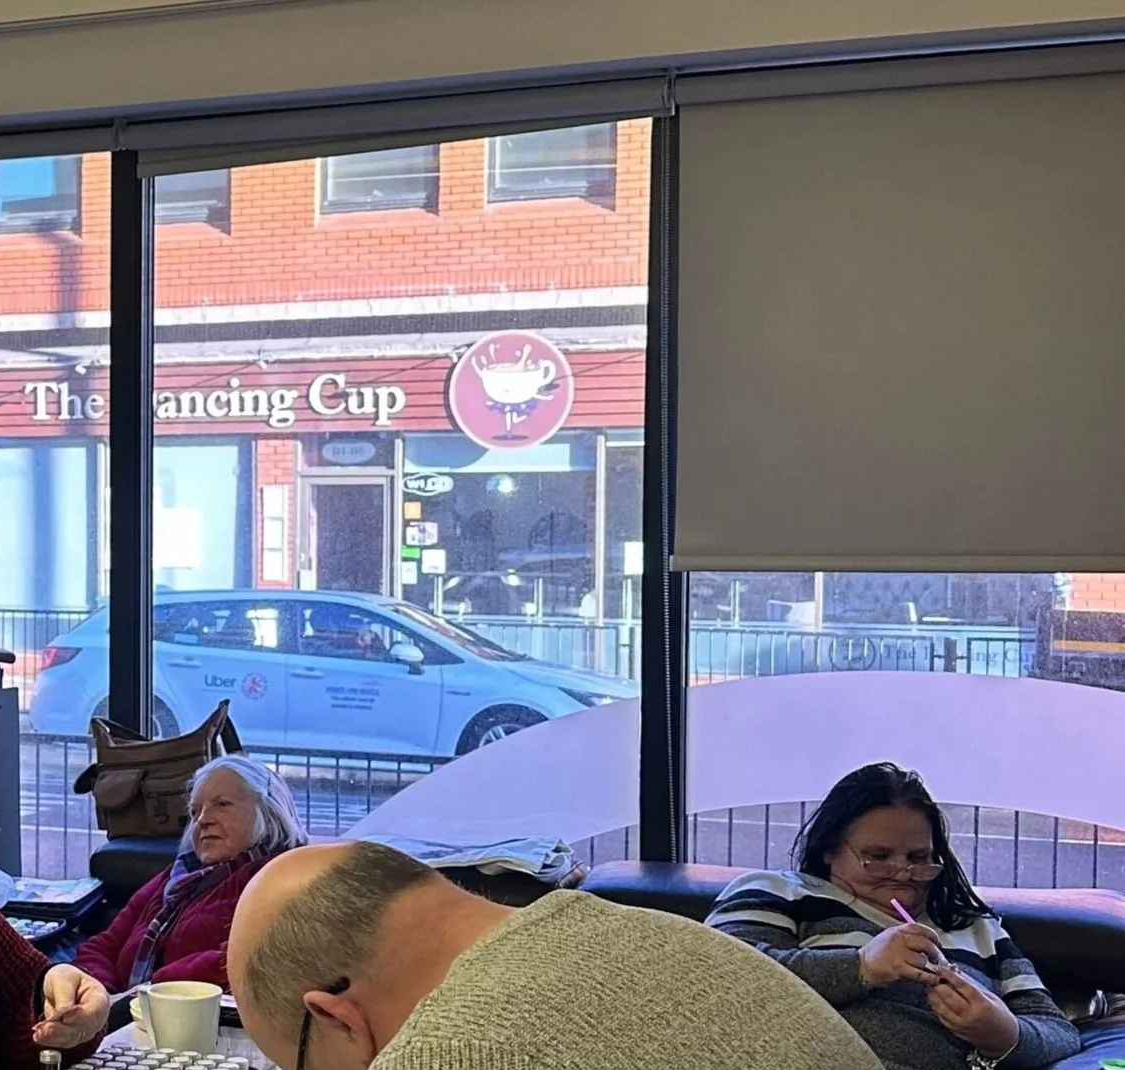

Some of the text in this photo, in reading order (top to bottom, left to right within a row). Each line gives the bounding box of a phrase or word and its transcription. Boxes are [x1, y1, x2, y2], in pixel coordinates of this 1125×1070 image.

[24, 373, 406, 427] The ancing Cup
[204, 674, 236, 688] Uber
